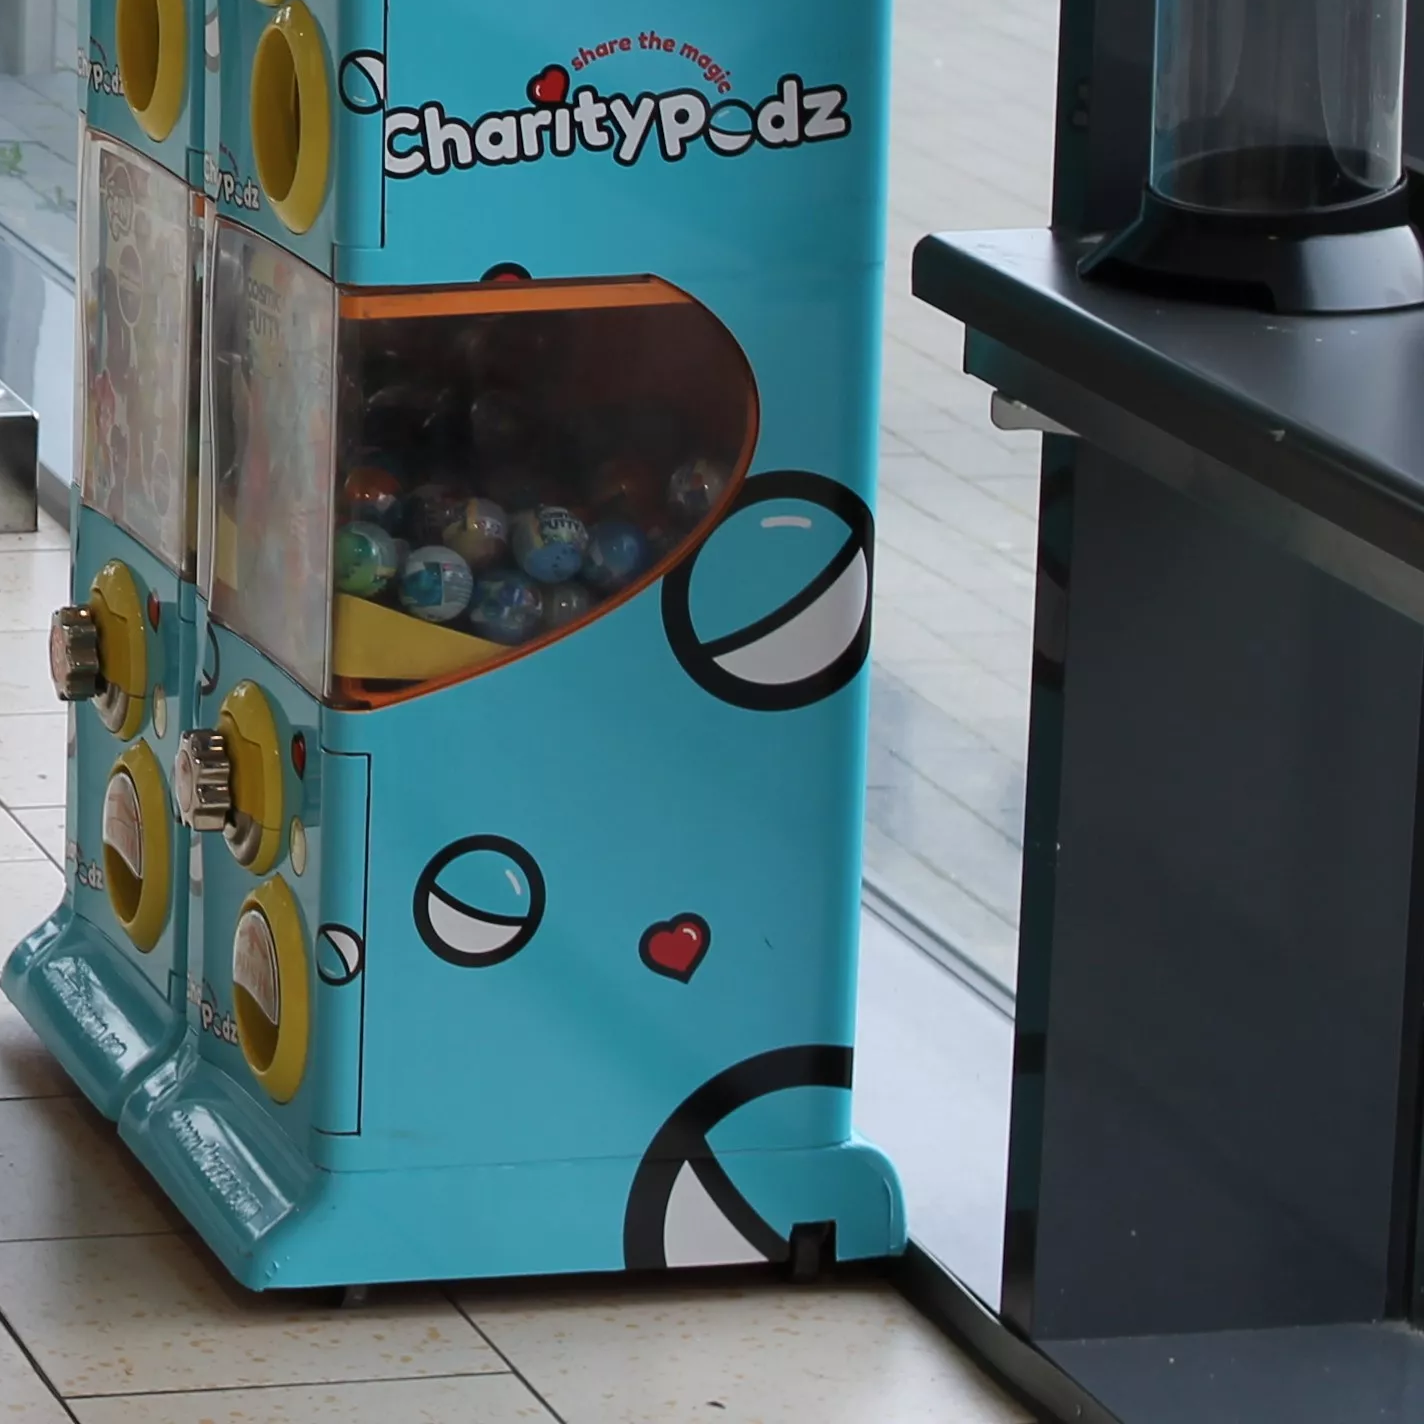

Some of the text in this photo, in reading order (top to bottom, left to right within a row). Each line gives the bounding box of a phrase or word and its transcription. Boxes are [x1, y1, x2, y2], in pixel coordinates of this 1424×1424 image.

[570, 30, 732, 95] share the magic
